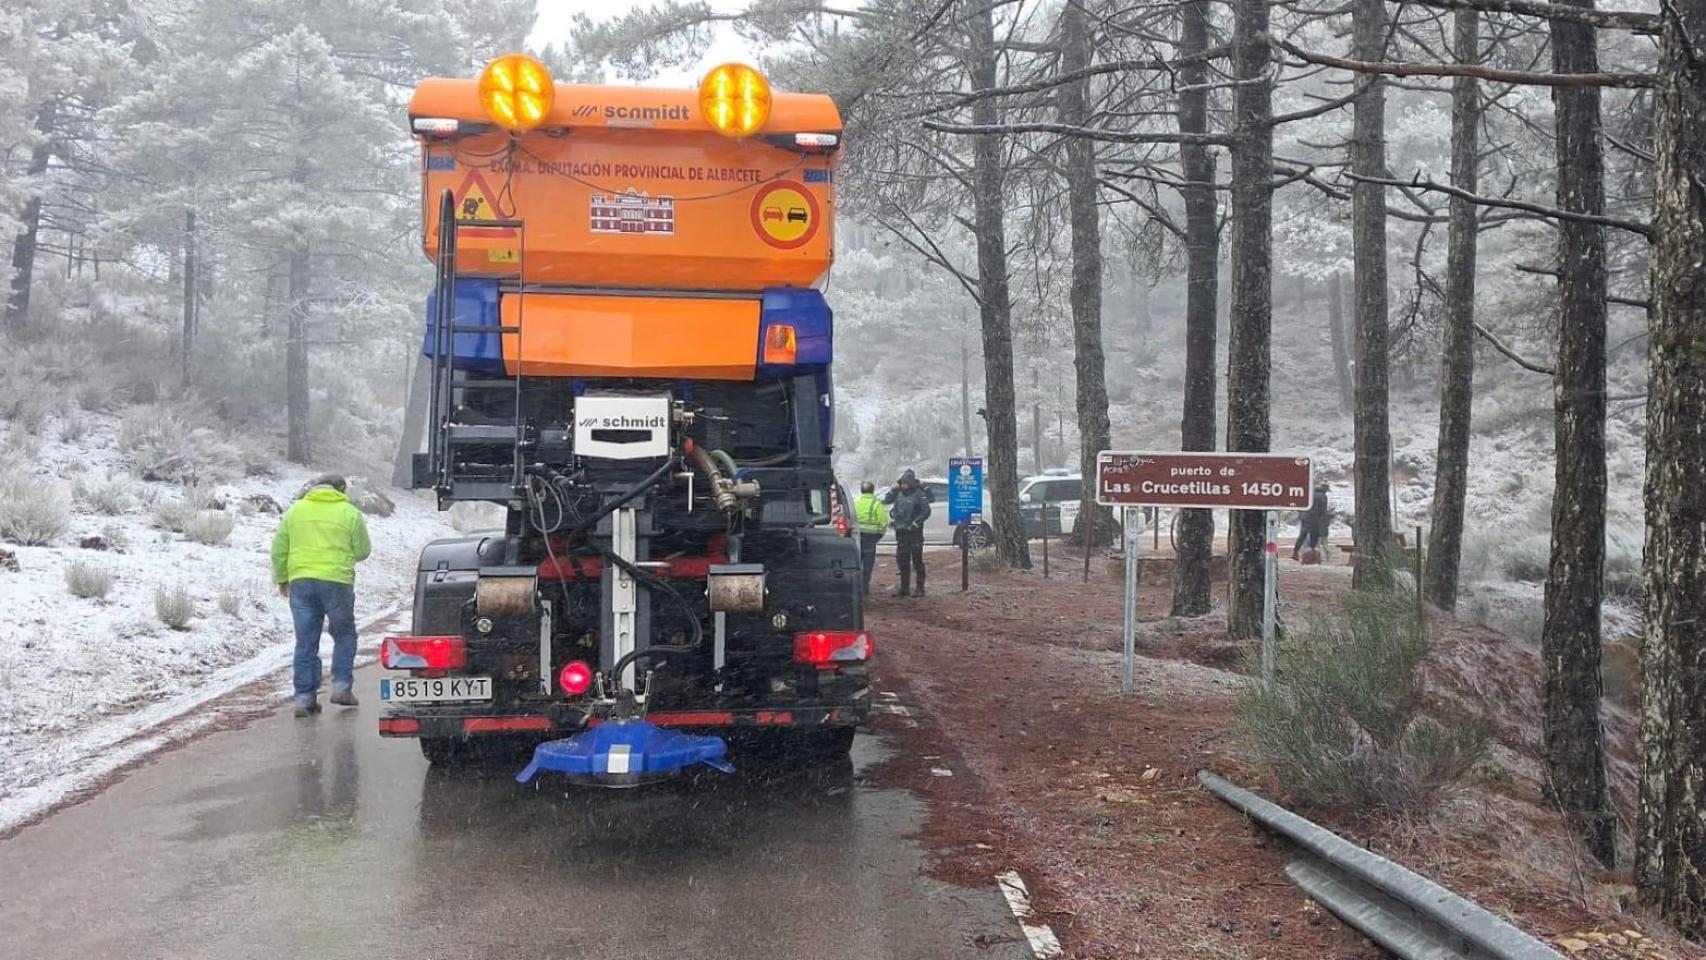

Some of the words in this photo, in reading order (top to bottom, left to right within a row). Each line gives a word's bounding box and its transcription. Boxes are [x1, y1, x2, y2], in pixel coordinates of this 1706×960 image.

[537, 160, 611, 177] DIPUTACIÓN
[614, 164, 686, 180] PROVINCIAL
[689, 167, 703, 180] DE
[706, 168, 761, 182] ALBACETE
[602, 415, 666, 428] schmidt
[1170, 465, 1212, 477] puerto
[1219, 465, 1235, 476] de
[1104, 480, 1132, 493] Las
[1141, 480, 1231, 495] Crucetillas
[1241, 482, 1283, 496] 1450
[1288, 486, 1304, 497] m
[395, 680, 443, 698] 8519
[451, 679, 489, 696] KYT
